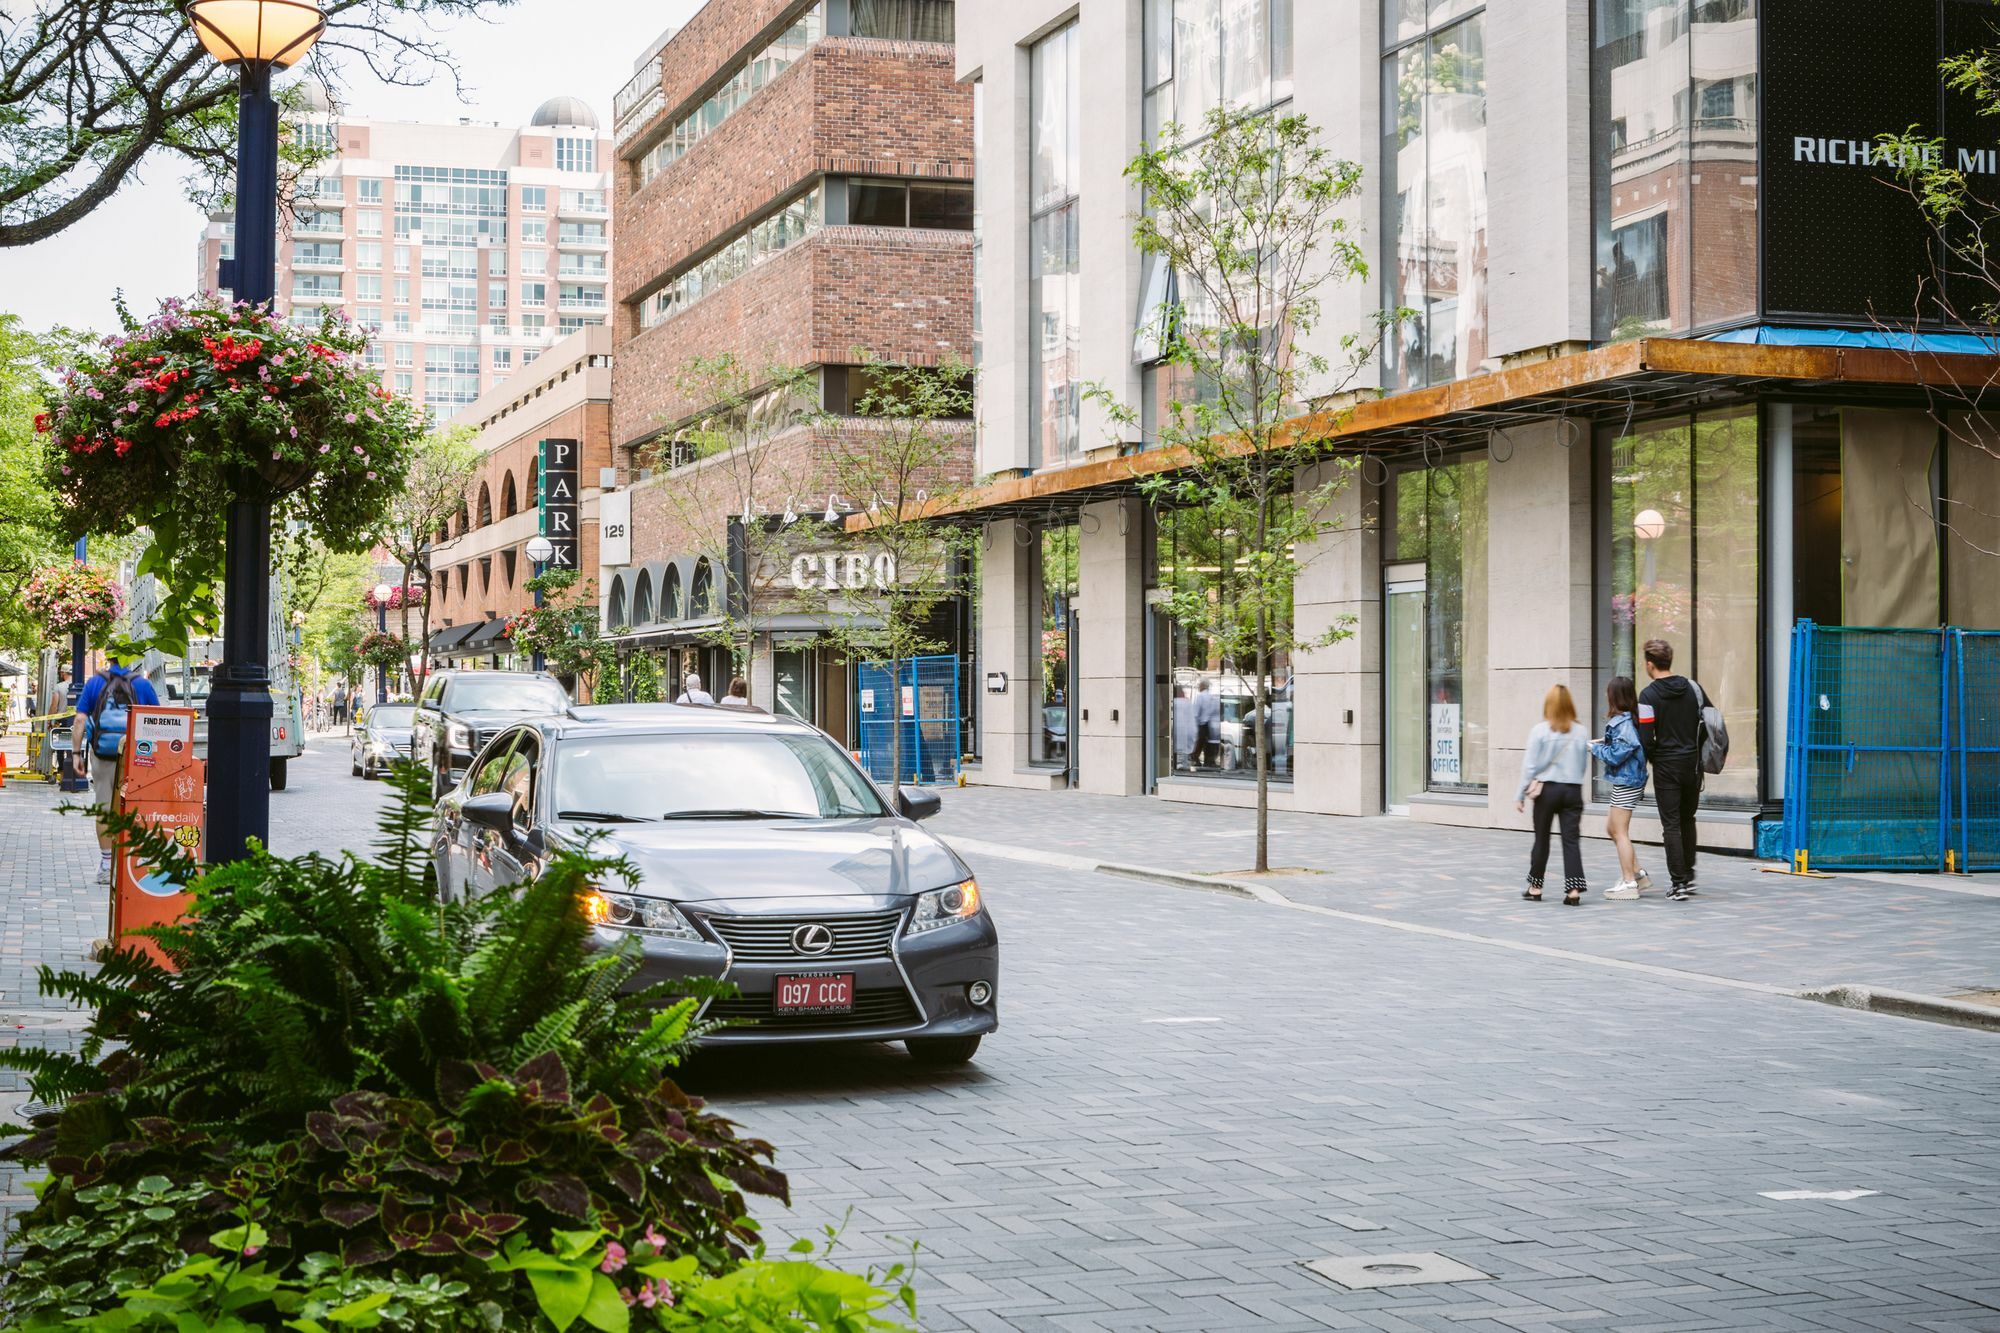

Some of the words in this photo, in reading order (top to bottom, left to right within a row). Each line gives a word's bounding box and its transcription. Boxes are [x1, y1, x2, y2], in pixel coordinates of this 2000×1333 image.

[1958, 148, 1996, 174] MI
[551, 444, 572, 565] PARK
[604, 524, 625, 539] 129
[791, 552, 896, 590] CIBO
[143, 717, 158, 725] FIND
[158, 718, 182, 727] RENTAL
[1436, 739, 1453, 755] SITE
[1432, 758, 1459, 773] OFFICE
[783, 984, 810, 1004] 097
[819, 983, 847, 1003] CCC
